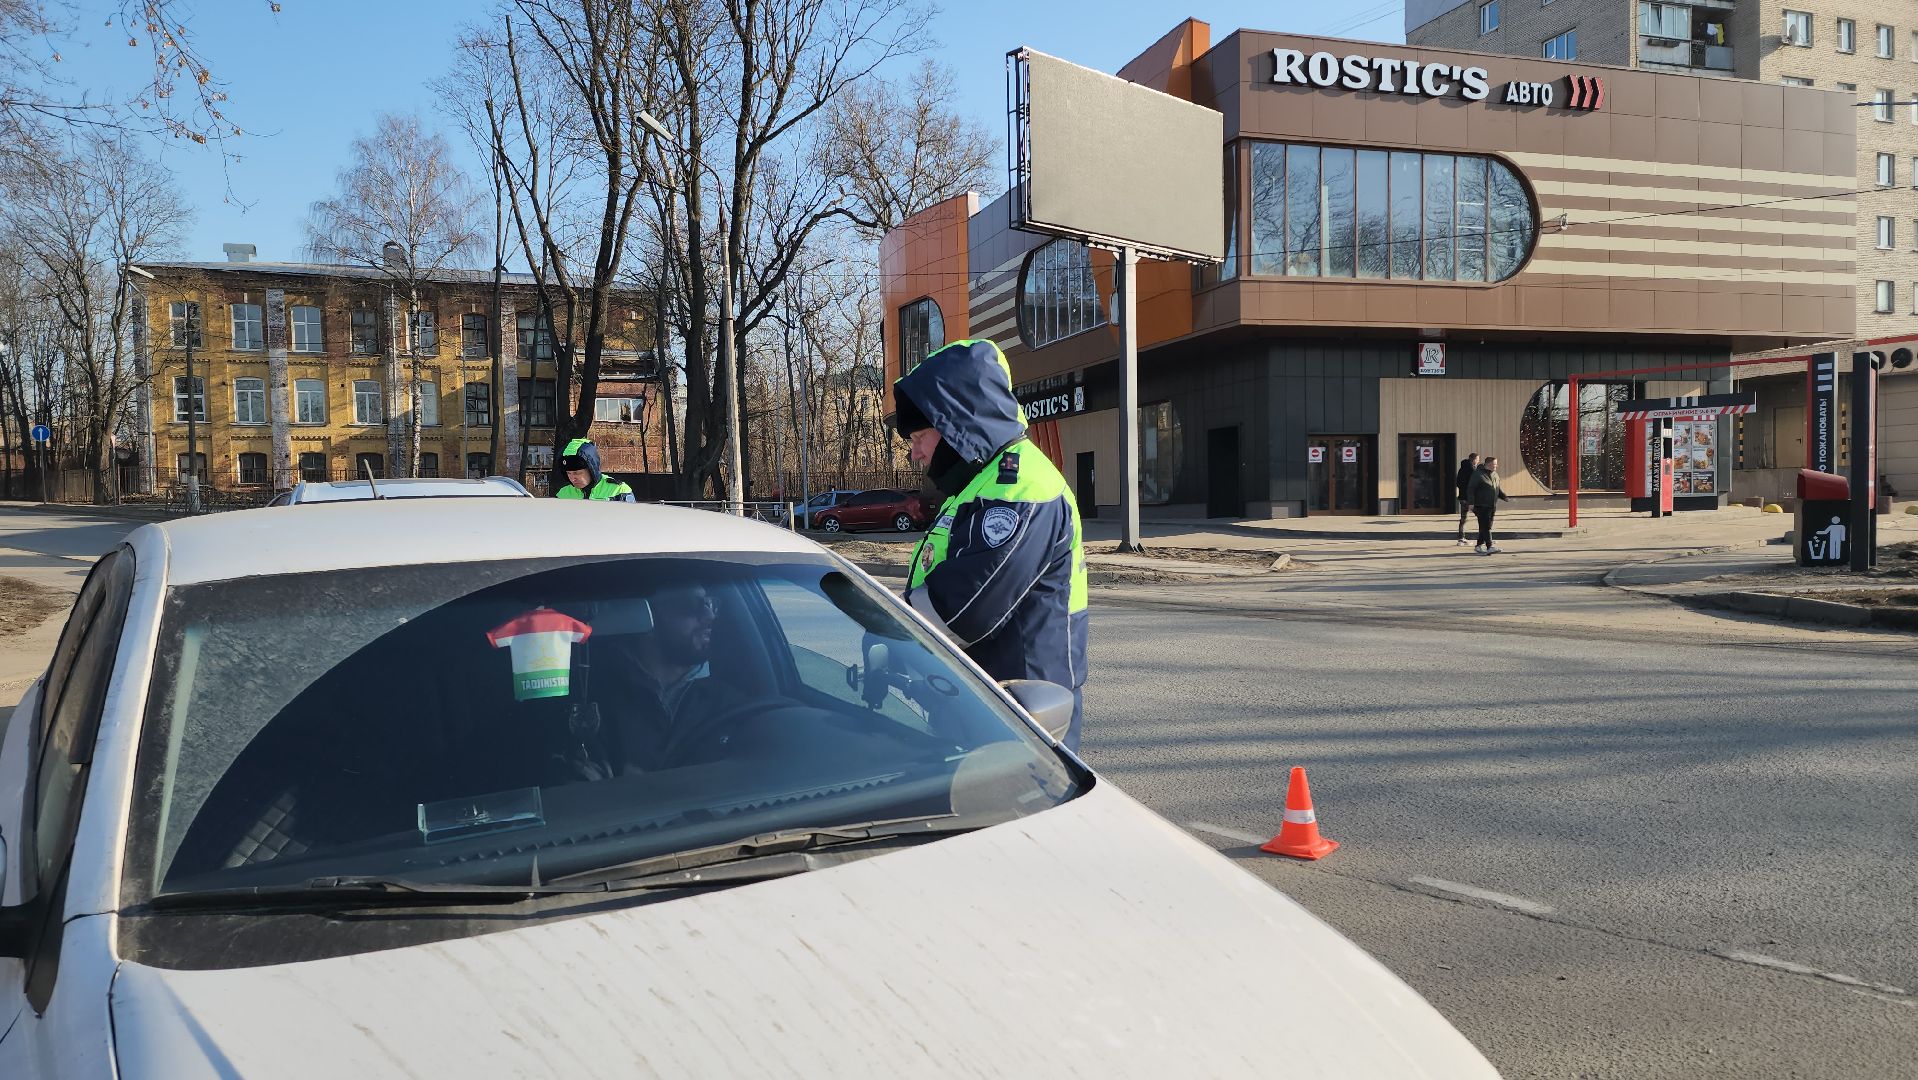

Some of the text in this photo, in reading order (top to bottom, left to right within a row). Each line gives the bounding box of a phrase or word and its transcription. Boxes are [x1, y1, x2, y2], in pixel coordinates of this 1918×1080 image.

[1273, 48, 1490, 100] ROSTIC'S
[1506, 81, 1554, 106] АВТО
[1020, 394, 1069, 420] OSTIC'S
[1819, 398, 1828, 463] ПОЖАЛОВАТЬ!
